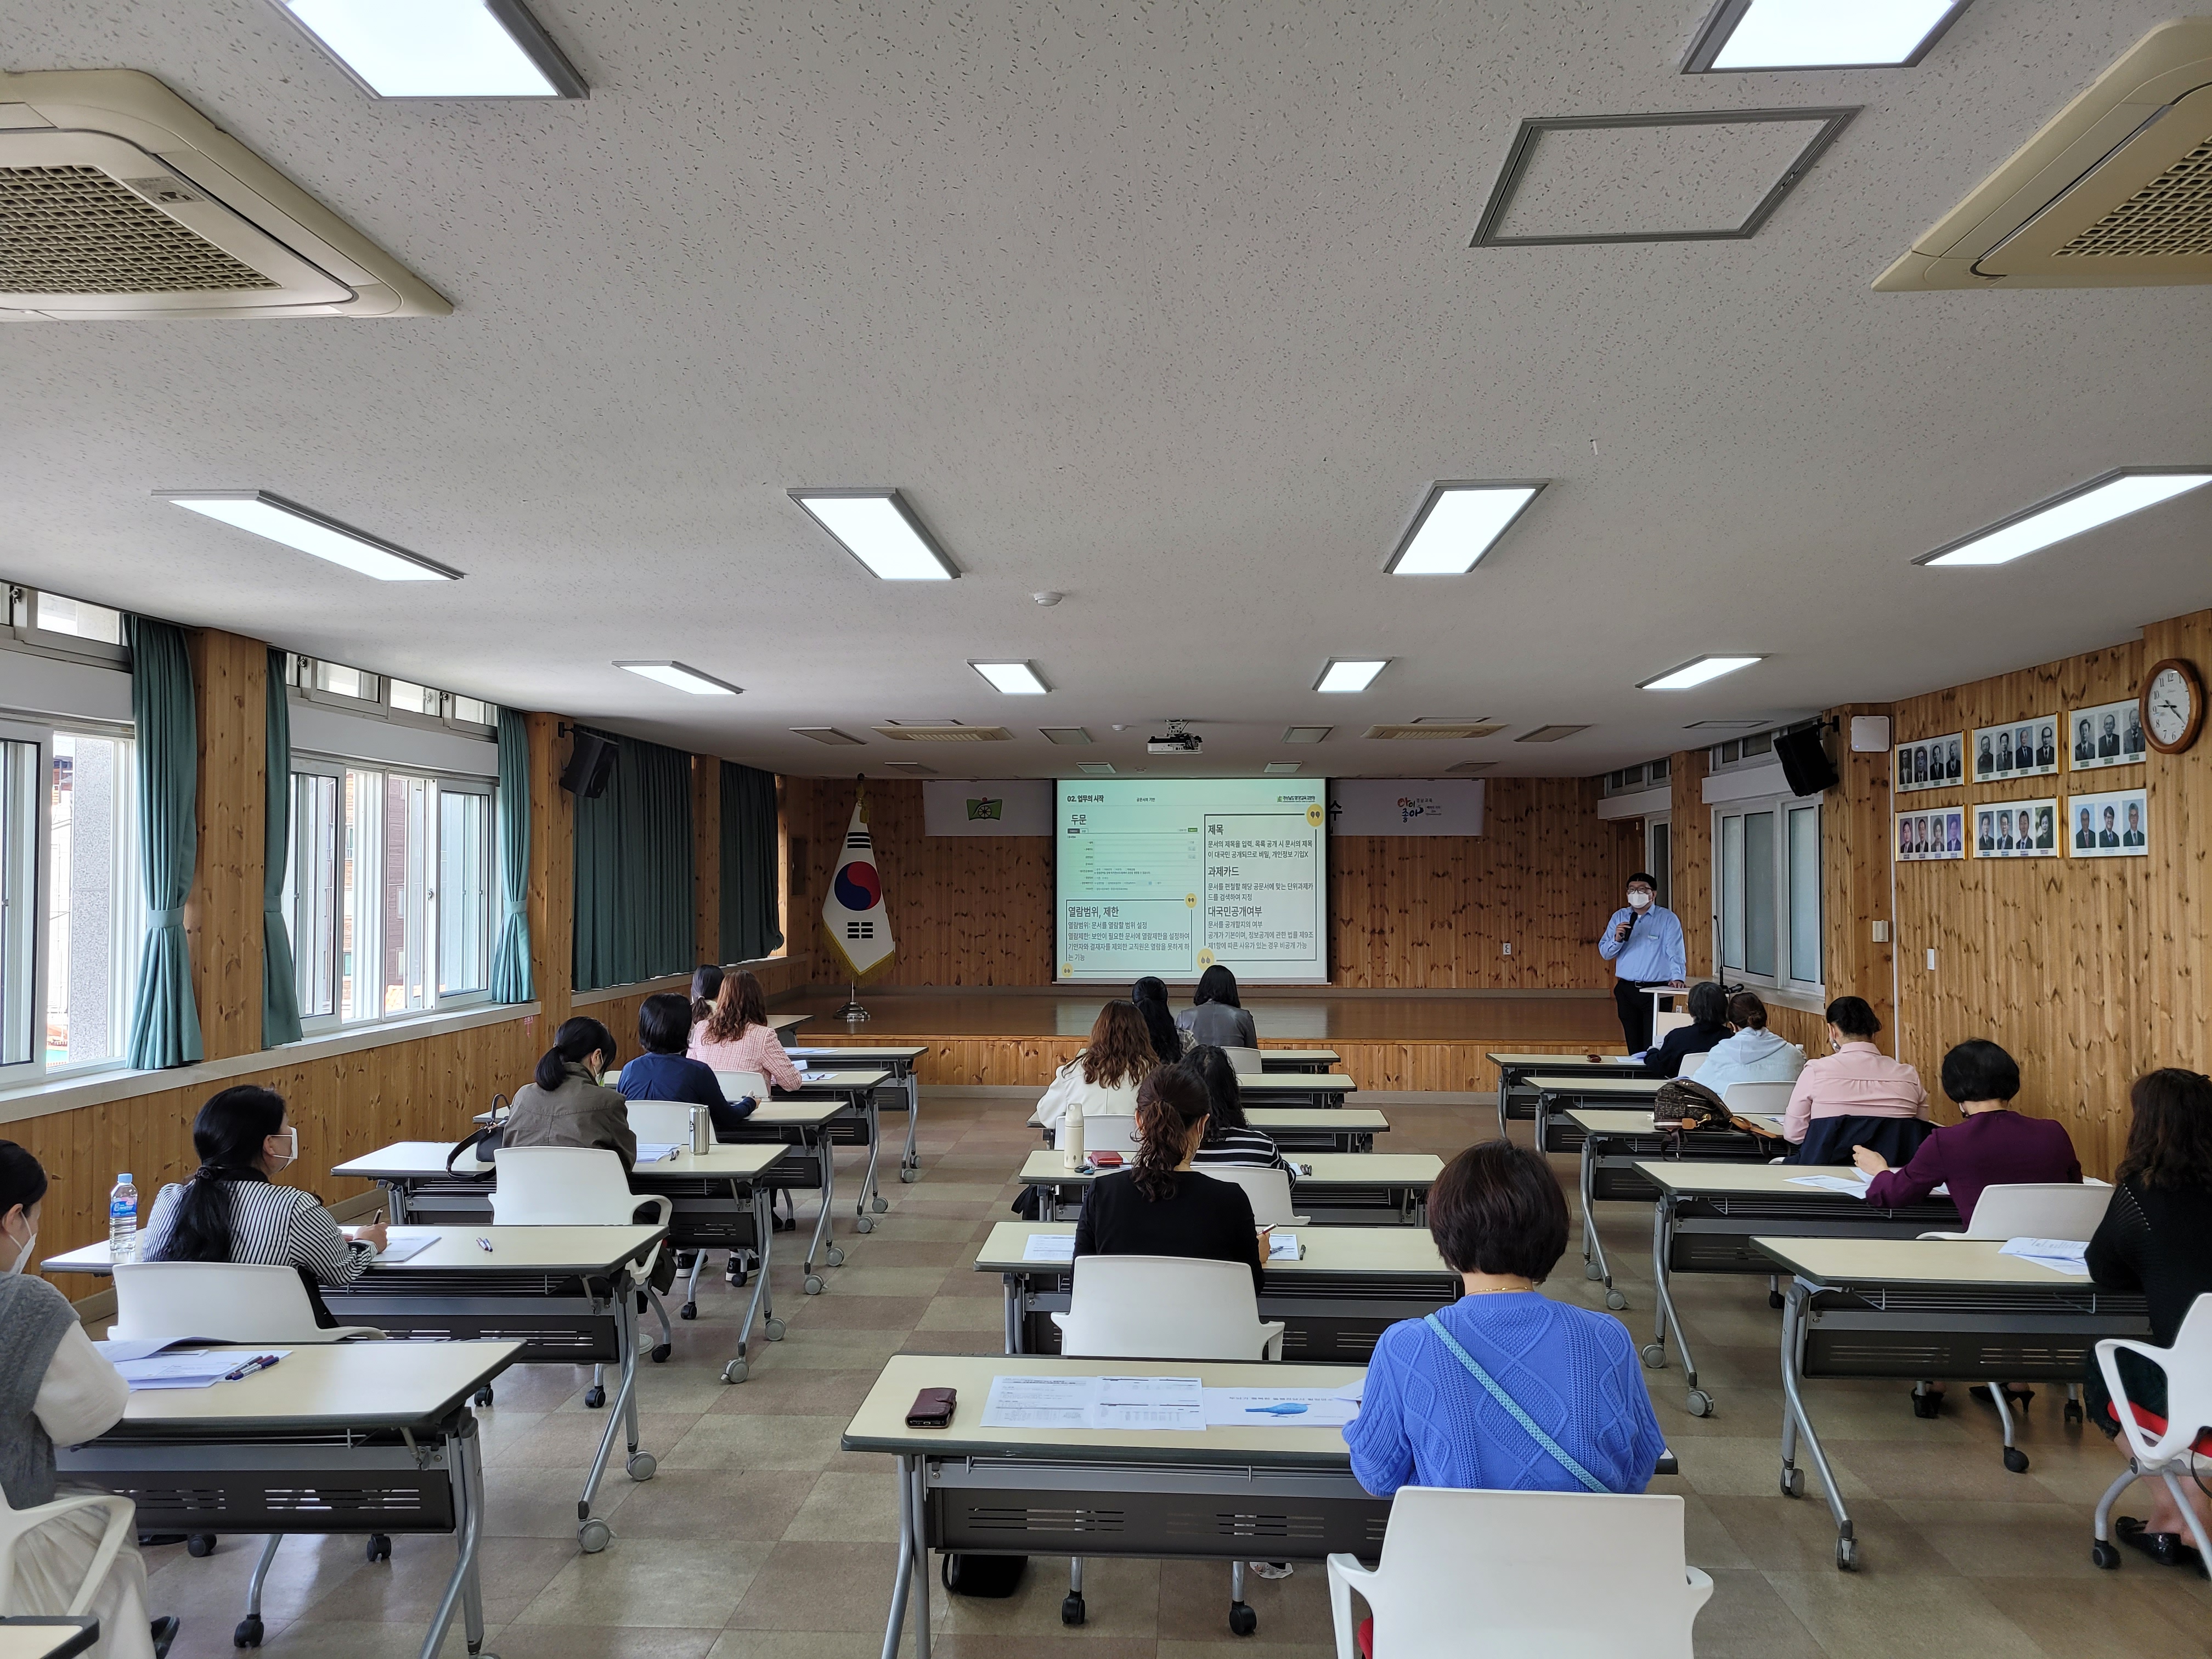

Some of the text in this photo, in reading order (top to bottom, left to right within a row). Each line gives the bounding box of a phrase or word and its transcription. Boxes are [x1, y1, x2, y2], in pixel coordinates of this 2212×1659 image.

[2159, 678, 2164, 687] 11
[2168, 673, 2174, 682] 12
[2153, 691, 2159, 700] 10
[2155, 719, 2160, 727] 8
[2163, 730, 2167, 740] 7
[2172, 731, 2176, 741] 6
[1077, 794, 1093, 803] 업무의
[1093, 794, 1104, 803] 시작
[1397, 797, 1415, 808] 아이
[1330, 800, 1342, 821] 수
[1402, 807, 1424, 823] 좋아
[1071, 814, 1087, 825] 두문
[1208, 824, 1224, 835] 제목
[1208, 866, 1239, 877] 과제카드
[1068, 906, 1119, 918] 열람범위, 제한
[1208, 906, 1262, 917] 대국민공개여부
[1225, 932, 1247, 940] 기본이며,
